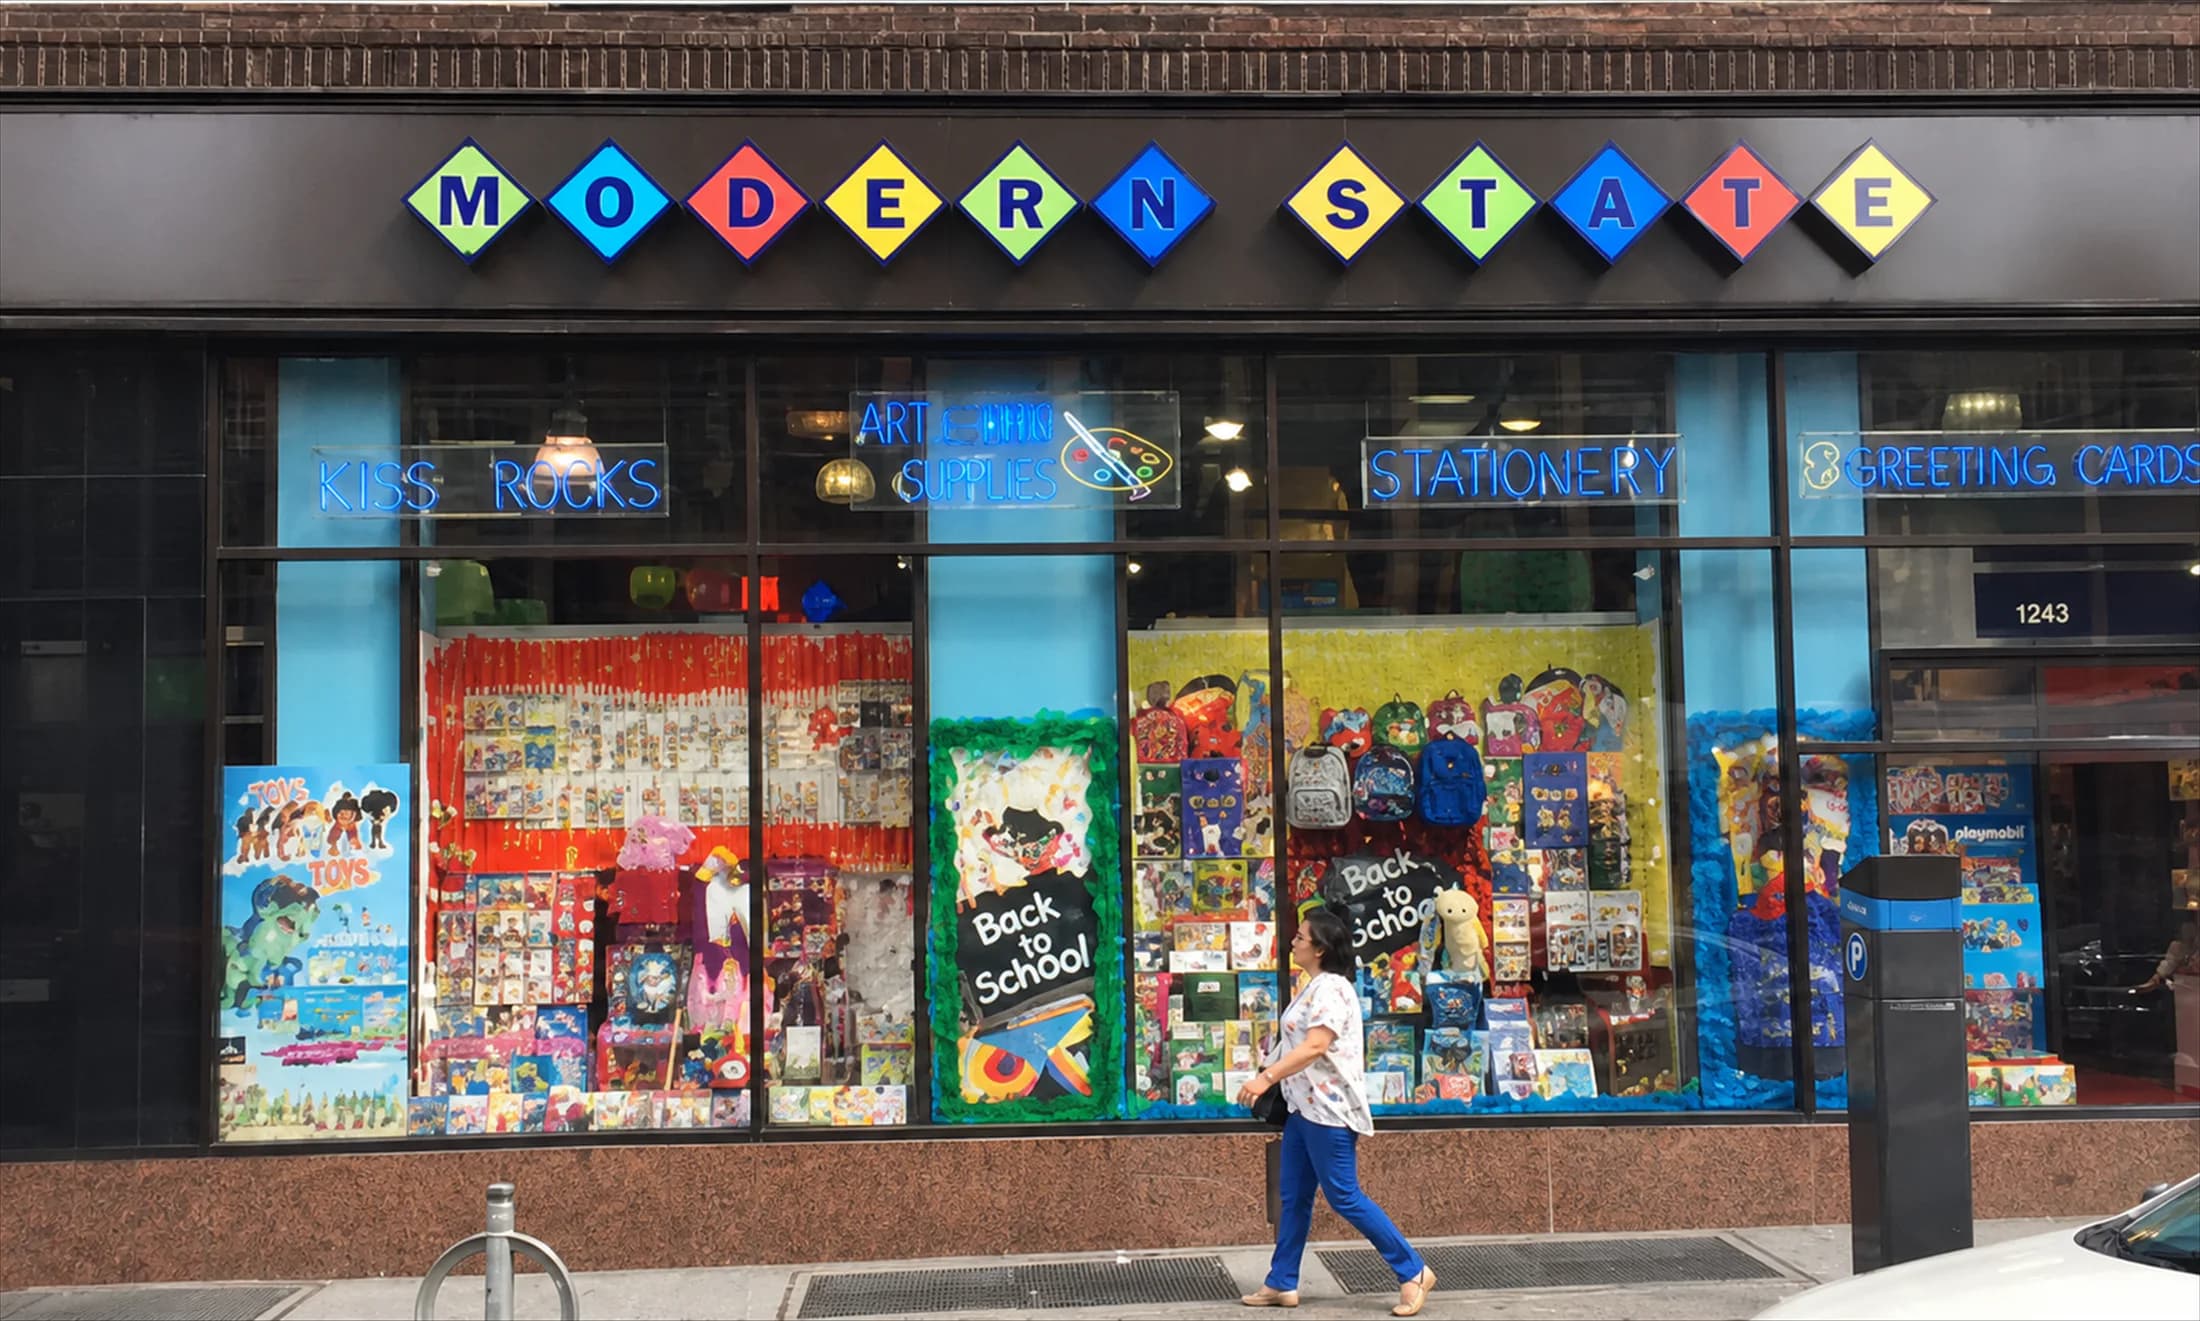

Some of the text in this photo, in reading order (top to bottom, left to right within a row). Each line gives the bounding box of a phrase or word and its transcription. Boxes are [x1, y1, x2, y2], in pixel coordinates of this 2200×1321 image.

[439, 176, 1894, 229] MODERN STATE
[860, 401, 931, 444] ART
[319, 459, 661, 511] KISS ROCKS
[901, 458, 1056, 501] SUPPLIES
[1371, 447, 1675, 499] STATIONERY
[1845, 445, 2055, 488] GREETING
[2015, 603, 2069, 624] 1243
[1955, 825, 2026, 842] playmobil
[308, 858, 370, 888] TOYS
[1341, 848, 1420, 895] Back
[1382, 885, 1412, 909] to
[971, 891, 1061, 948] Back
[1017, 932, 1053, 960] to
[1851, 941, 1863, 972] P
[974, 933, 1091, 1004] School
